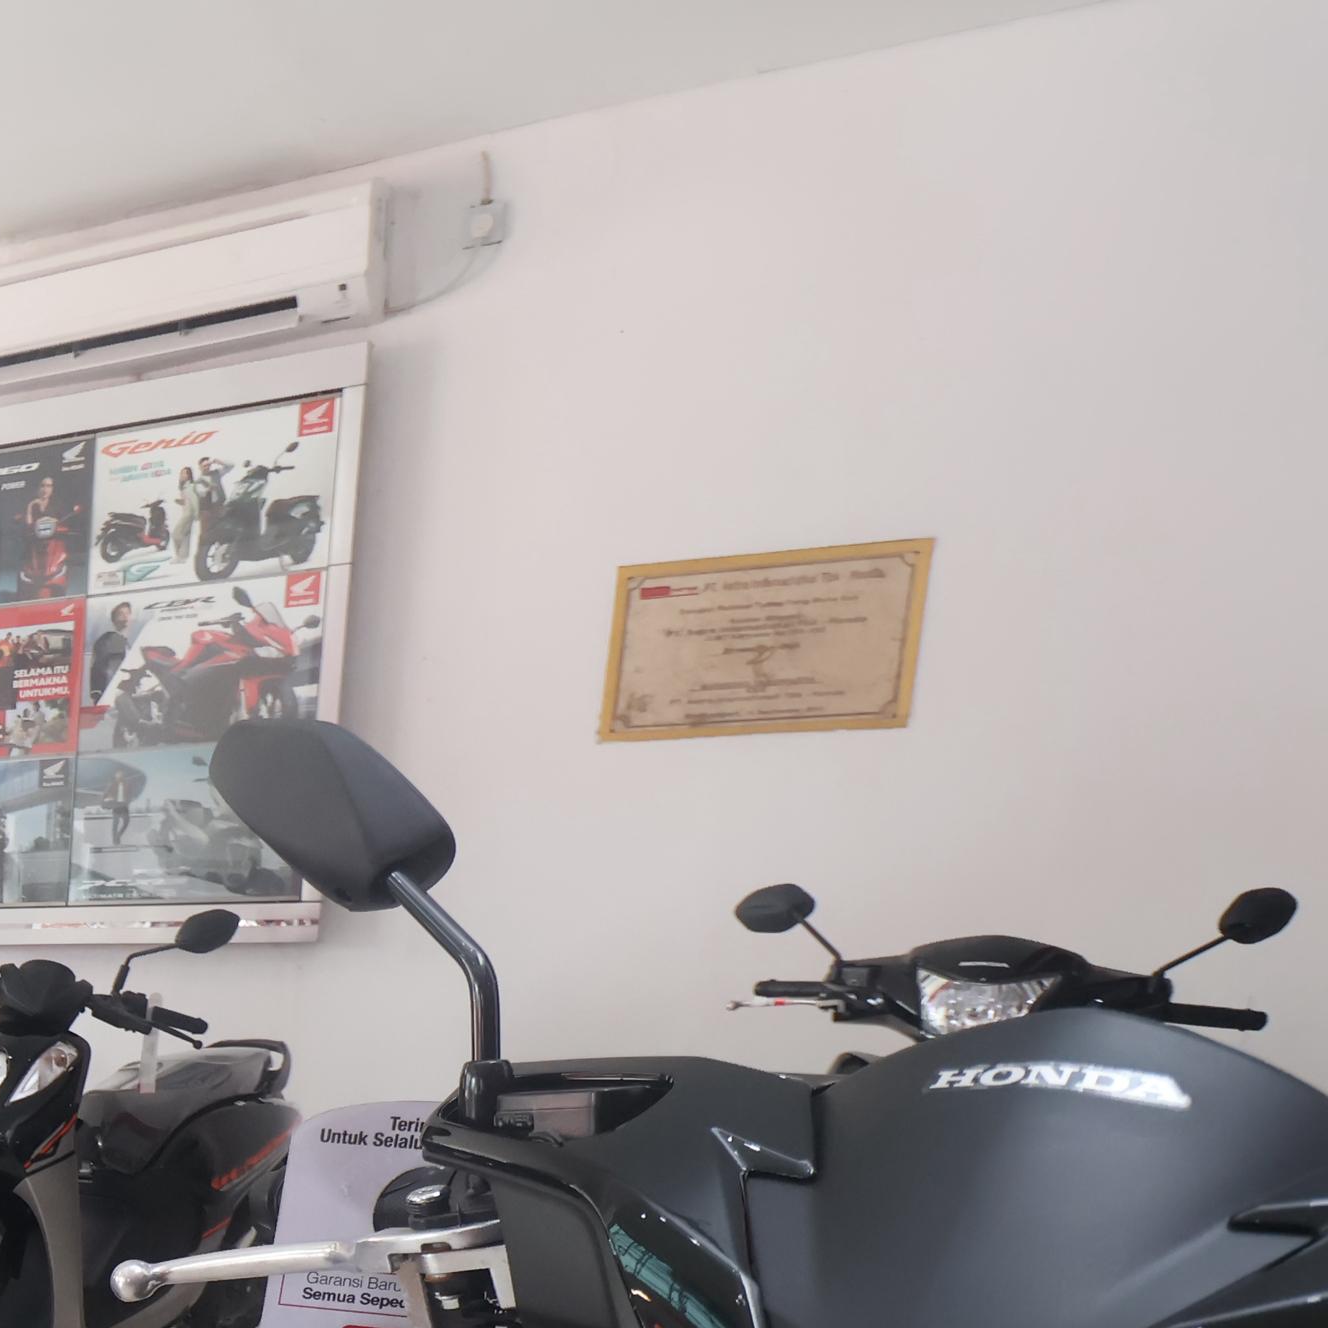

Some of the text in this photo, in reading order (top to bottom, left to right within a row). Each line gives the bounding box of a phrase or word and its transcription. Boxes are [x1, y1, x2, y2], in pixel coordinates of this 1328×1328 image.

[101, 430, 219, 458] Genio
[14, 664, 70, 679] SELAMA ITU
[13, 676, 68, 689] BERMAKNA
[929, 1063, 1184, 1104] HONDA
[320, 1128, 368, 1146] Untuk
[306, 1271, 364, 1289] Garansi
[302, 1287, 356, 1305] Semua
